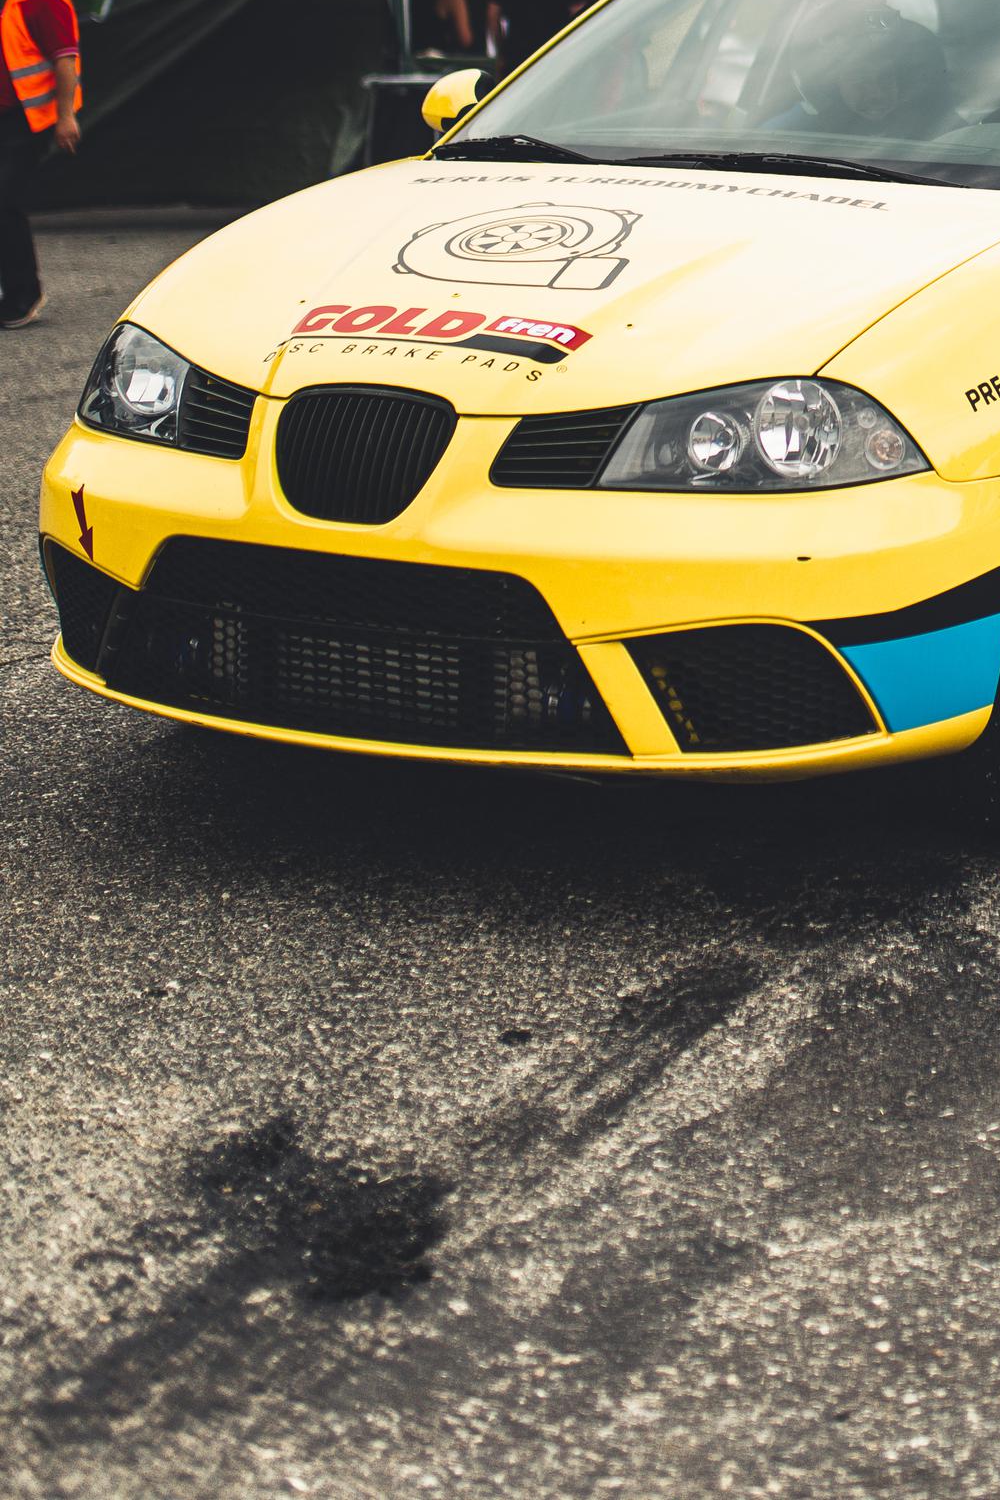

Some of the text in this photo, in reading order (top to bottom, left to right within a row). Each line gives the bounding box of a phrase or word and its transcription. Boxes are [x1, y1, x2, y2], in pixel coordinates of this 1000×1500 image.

[408, 175, 536, 185] SERVIS
[291, 304, 577, 345] GOLD fren
[263, 343, 543, 383] DISC BRAKE PADS
